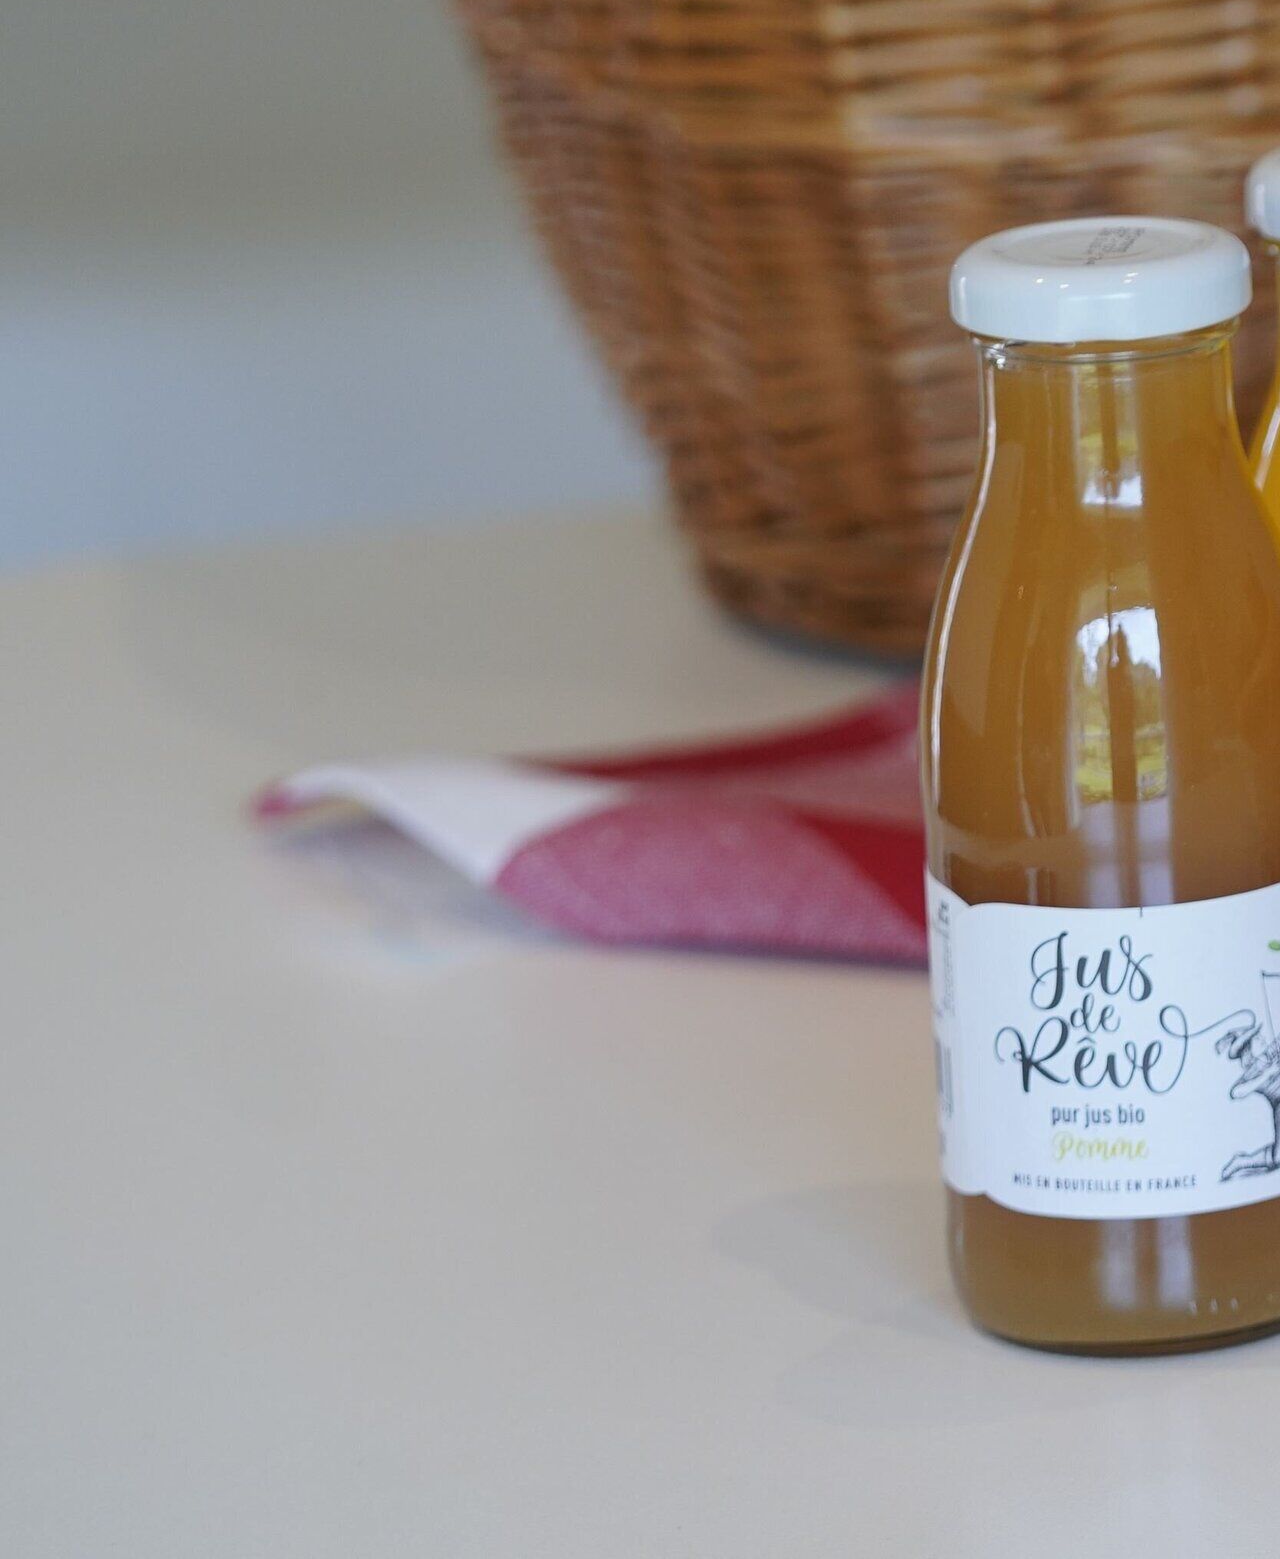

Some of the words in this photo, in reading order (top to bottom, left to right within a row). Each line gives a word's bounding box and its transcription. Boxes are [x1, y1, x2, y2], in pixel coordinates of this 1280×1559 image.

[1030, 930, 1154, 1010] Jus
[1069, 992, 1122, 1034] de
[994, 1004, 1190, 1094] Rêve
[1051, 1105, 1079, 1127] pur
[1084, 1103, 1112, 1128] jus
[1117, 1104, 1146, 1125] bio
[1052, 1130, 1151, 1164] Pomme
[1013, 1171, 1032, 1187] MIS
[1036, 1175, 1051, 1189] EN
[1056, 1178, 1120, 1192] BOUTEILLE
[1126, 1180, 1143, 1193] EN
[1149, 1174, 1198, 1191] FRANCE
